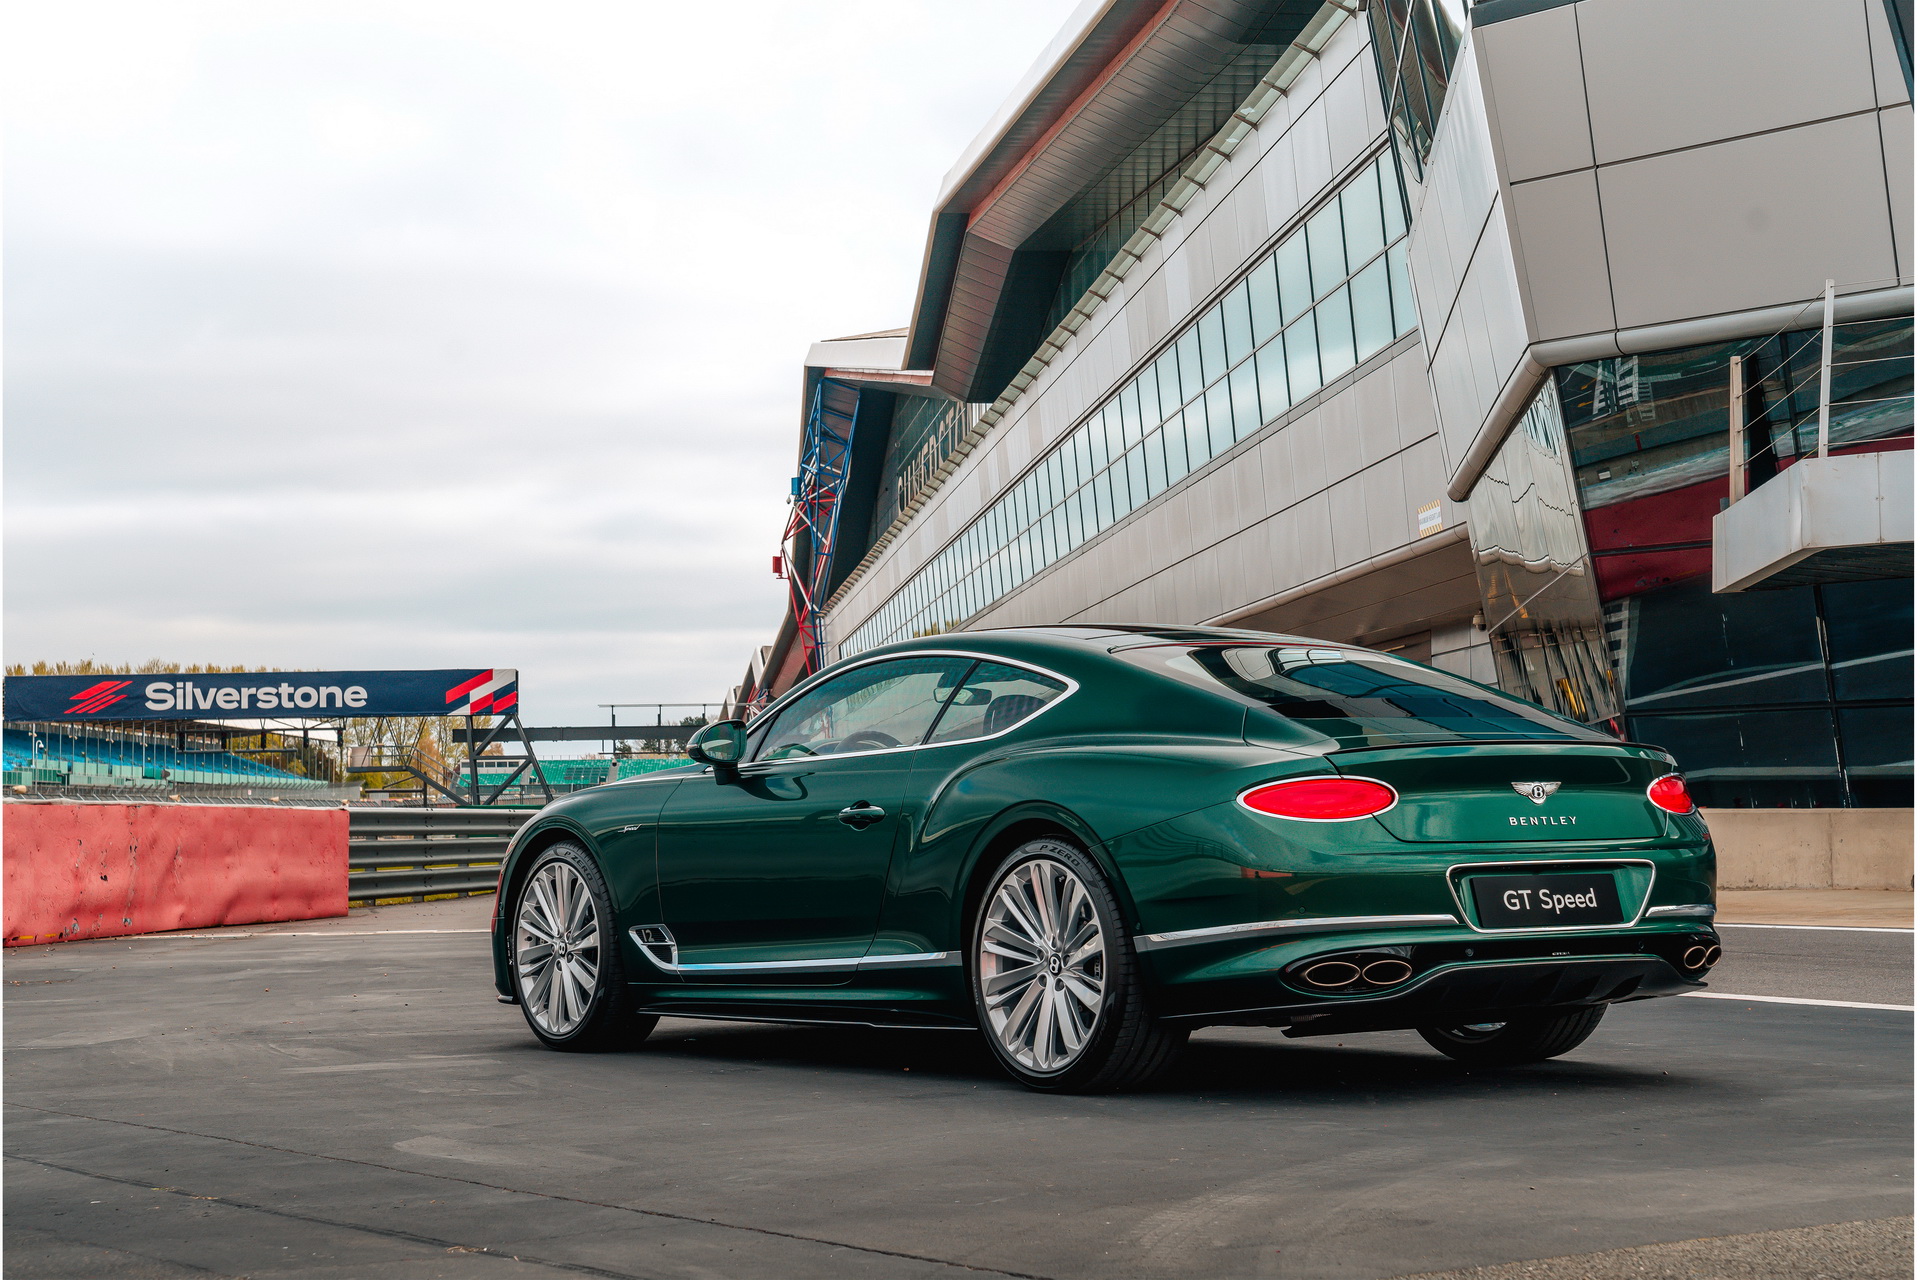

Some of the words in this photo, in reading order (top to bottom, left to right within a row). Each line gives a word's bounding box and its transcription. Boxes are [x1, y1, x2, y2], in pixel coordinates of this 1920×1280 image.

[144, 681, 368, 711] Silverstone
[1508, 816, 1577, 826] BENTLEY
[571, 854, 593, 881] ZERO
[1049, 845, 1081, 867] ZERO
[1503, 889, 1532, 911] GT
[1538, 887, 1598, 914] Speed
[641, 929, 655, 942] 12
